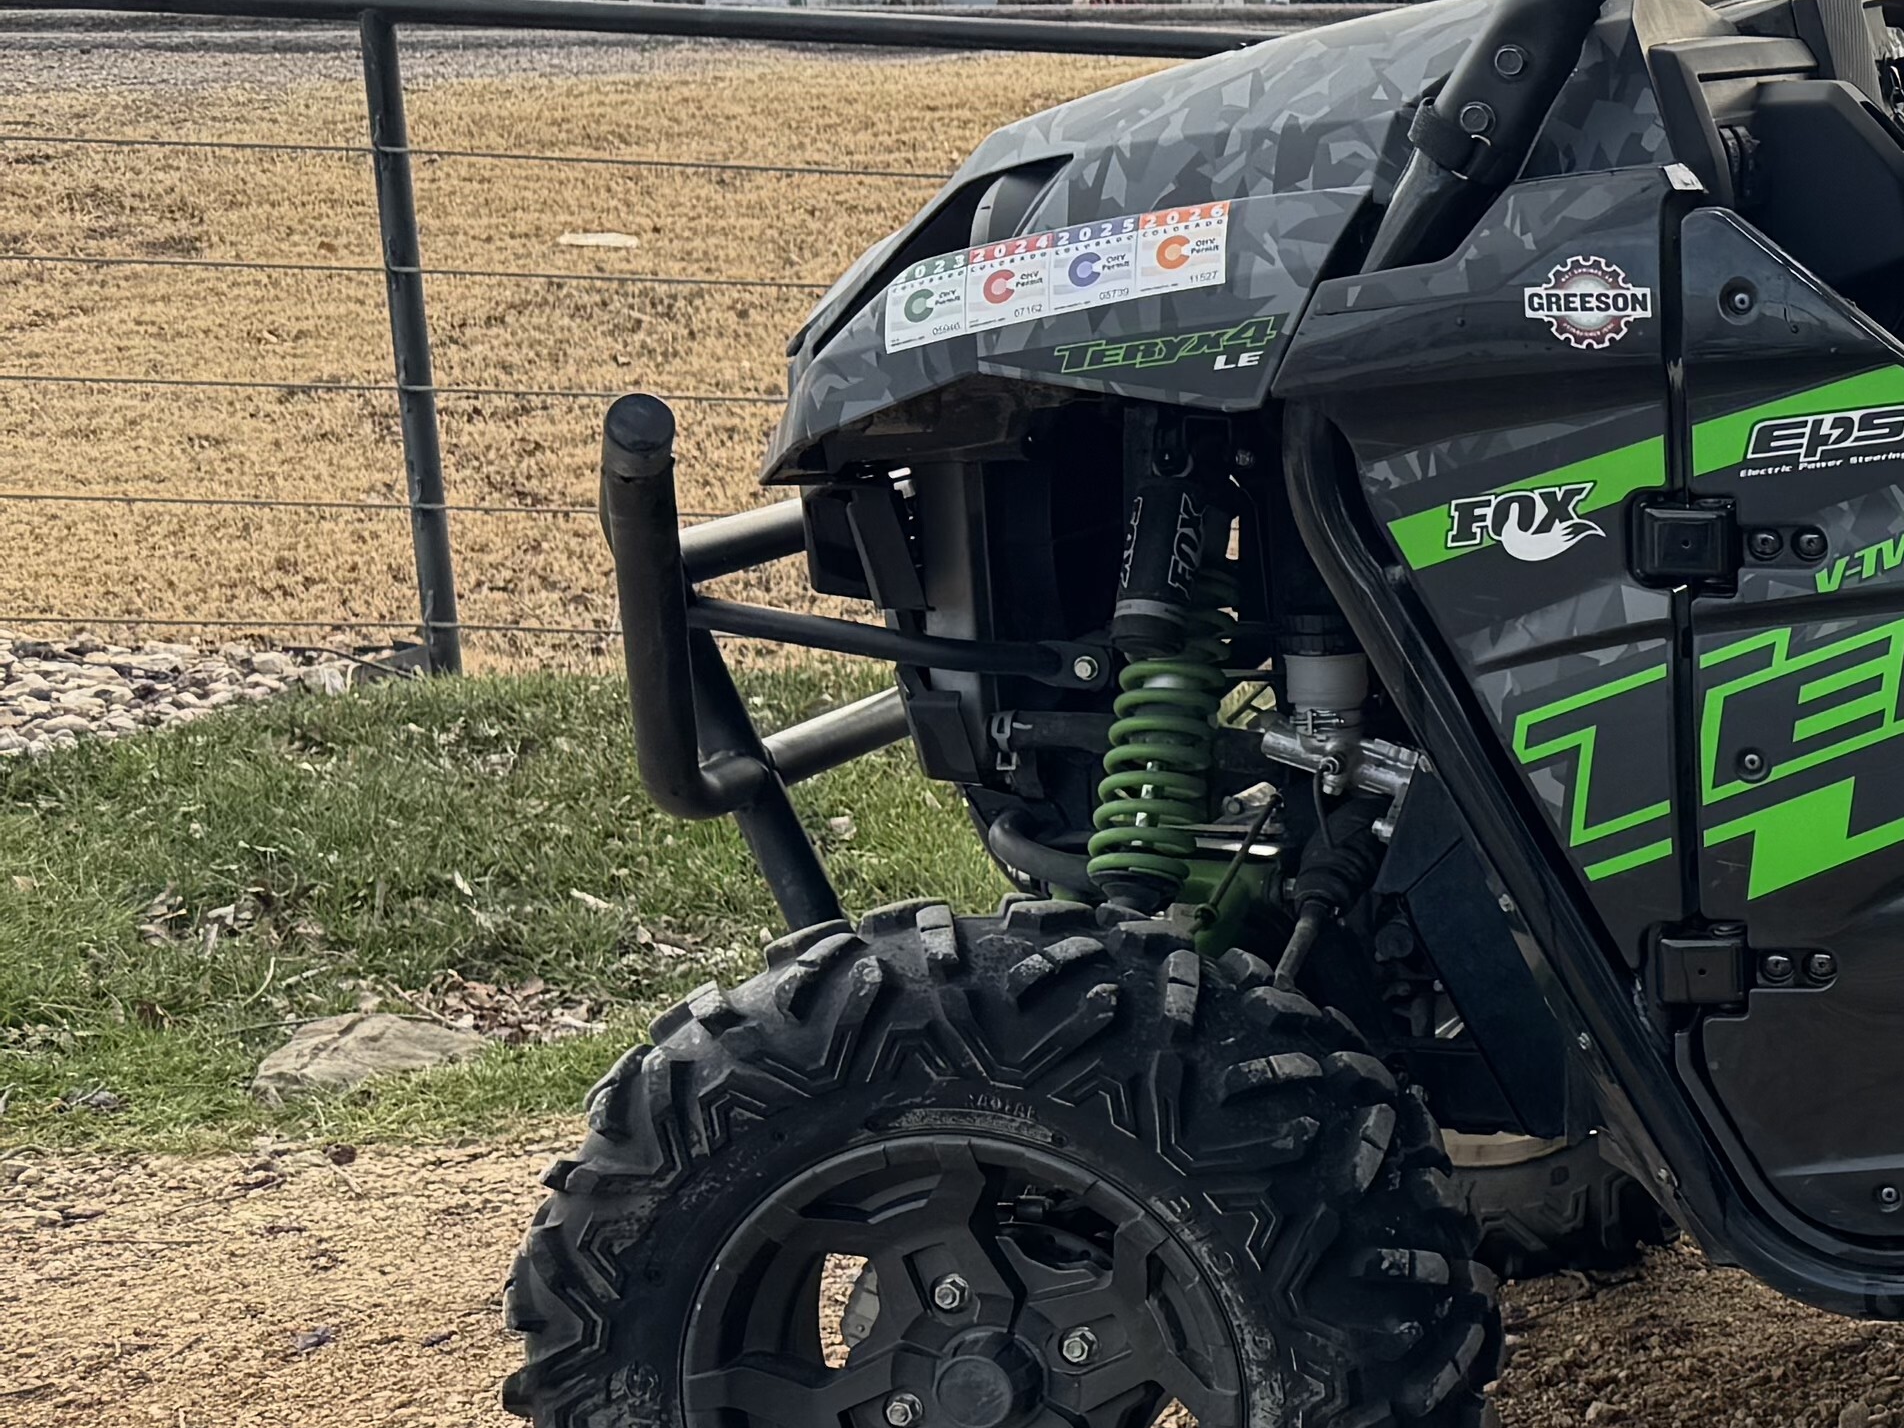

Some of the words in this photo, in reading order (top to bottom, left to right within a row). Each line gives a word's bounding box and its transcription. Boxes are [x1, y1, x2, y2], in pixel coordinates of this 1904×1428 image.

[1142, 204, 1225, 228] 2026
[1057, 218, 1134, 245] 2025
[1141, 219, 1224, 238] COLORADO
[971, 235, 1049, 263] 2024
[1054, 235, 1134, 256] COLORADO
[1190, 243, 1220, 255] Permit
[970, 251, 1047, 272] COLORADO
[1101, 260, 1130, 272] Permit
[1189, 270, 1219, 283] 11527
[1014, 304, 1043, 318] 07162
[1527, 292, 1649, 313] GREESON
[1213, 351, 1264, 370] LE
[1739, 464, 1793, 477] Electric
[1798, 458, 1843, 471] Power
[1446, 480, 1600, 552] FOX
[1167, 492, 1204, 601] FOX
